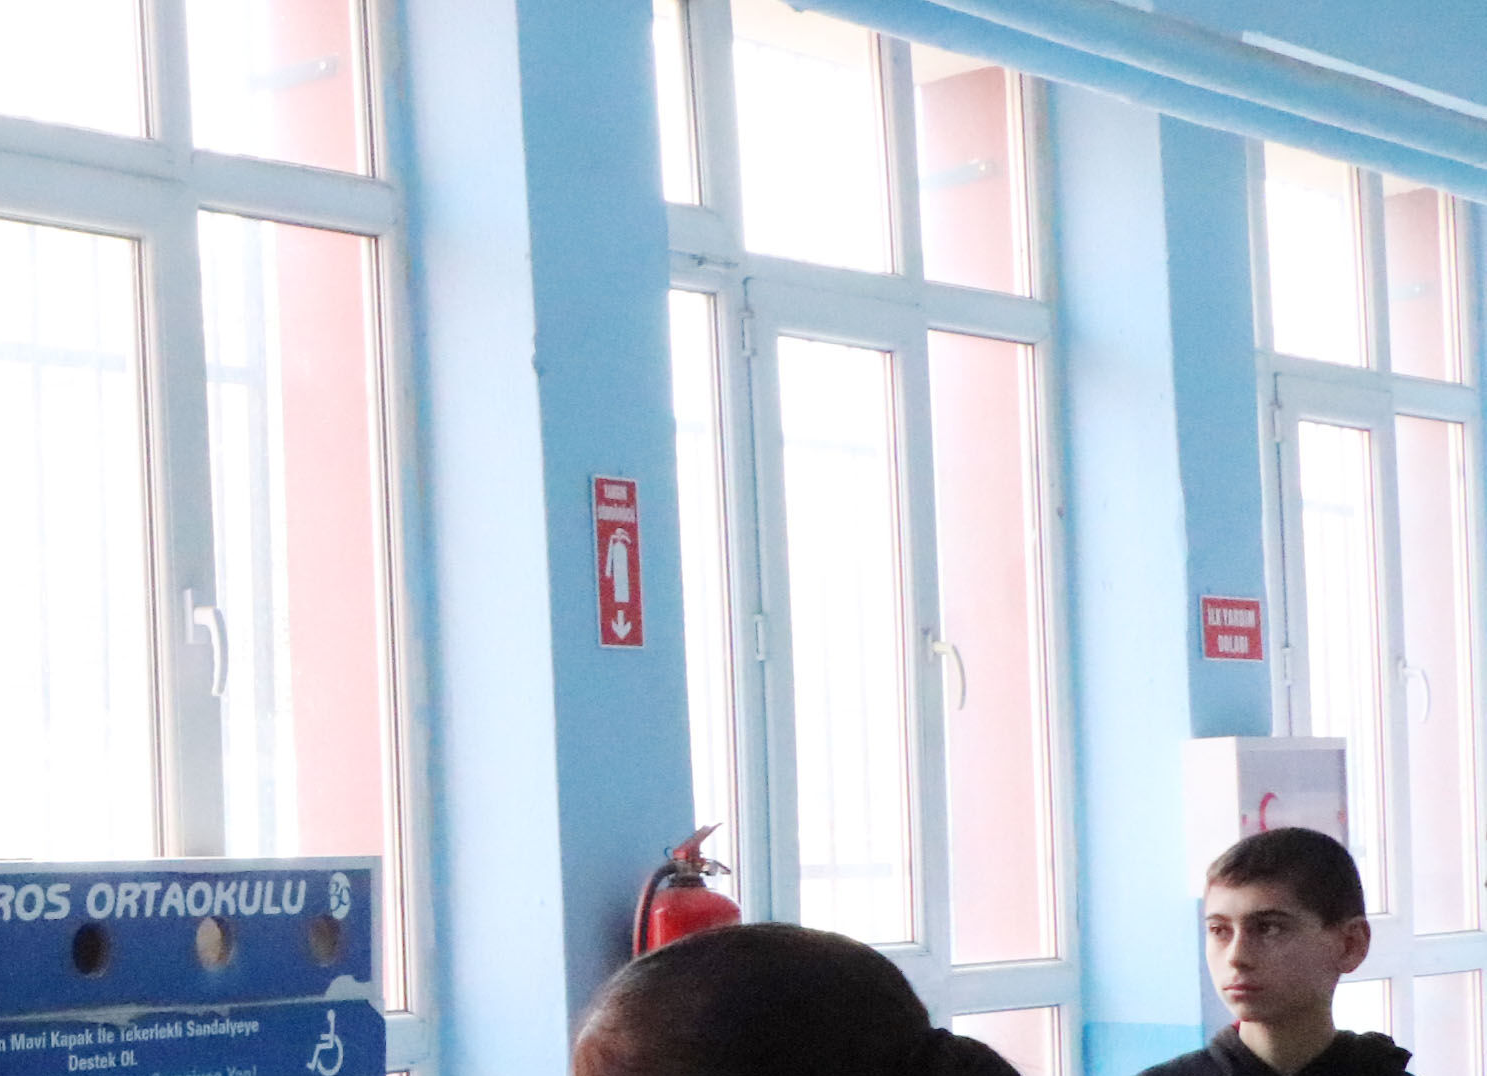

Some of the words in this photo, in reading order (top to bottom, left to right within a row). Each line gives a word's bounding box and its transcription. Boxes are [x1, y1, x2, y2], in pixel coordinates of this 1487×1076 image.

[85, 879, 308, 921] ORTAOKULU
[11, 1032, 47, 1051] Mavi
[50, 1028, 94, 1051] Kapak
[186, 1018, 260, 1038] Sandalyeye
[68, 1052, 117, 1072] Destek
